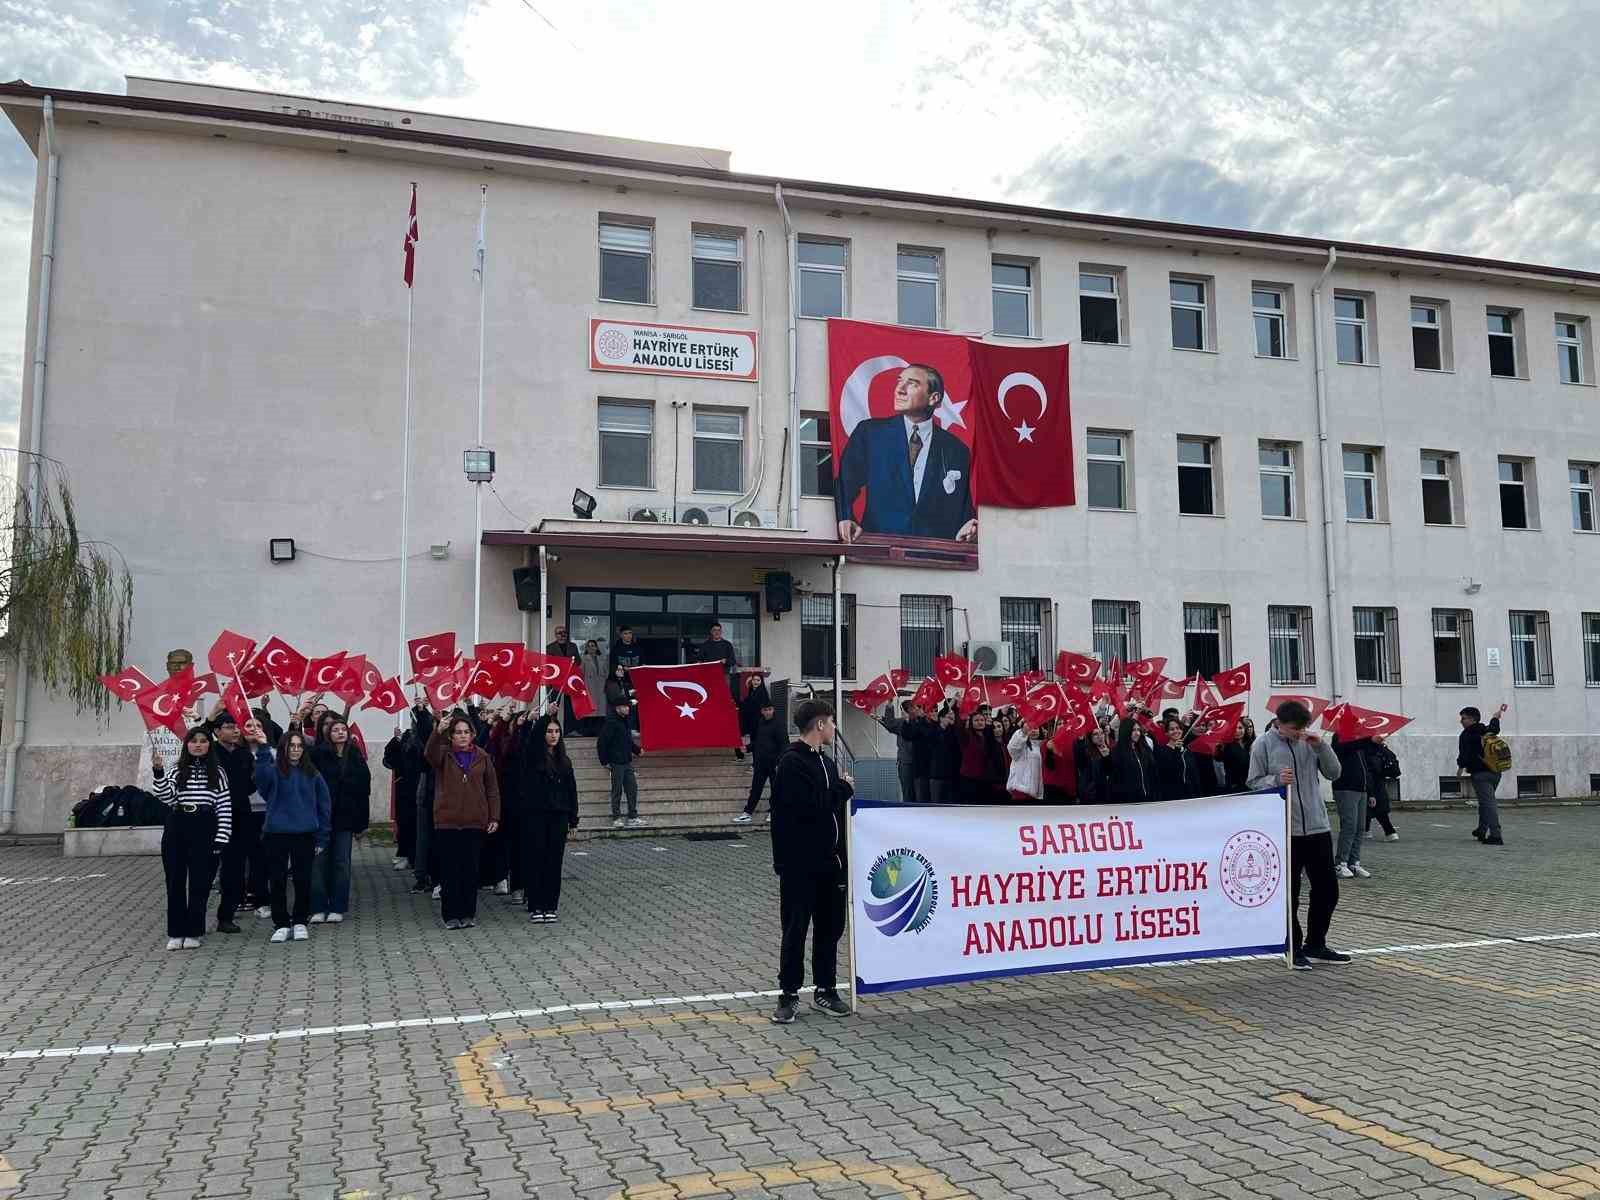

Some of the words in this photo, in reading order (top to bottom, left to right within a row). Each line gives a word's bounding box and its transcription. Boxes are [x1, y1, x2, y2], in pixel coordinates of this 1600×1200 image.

[633, 338, 687, 354] HAYRİYE
[690, 343, 740, 358] ERTÜRK
[633, 353, 692, 369] ANADOLU
[695, 356, 734, 372] LİSESİ
[1019, 815, 1143, 856] SARIGÖL
[886, 847, 916, 858] HAYRİYE
[951, 865, 1085, 908] HAYRİYE
[1097, 858, 1208, 898] ERTÜRK
[963, 913, 1103, 956] ANADOLU
[1114, 900, 1201, 942] LİSESİ
